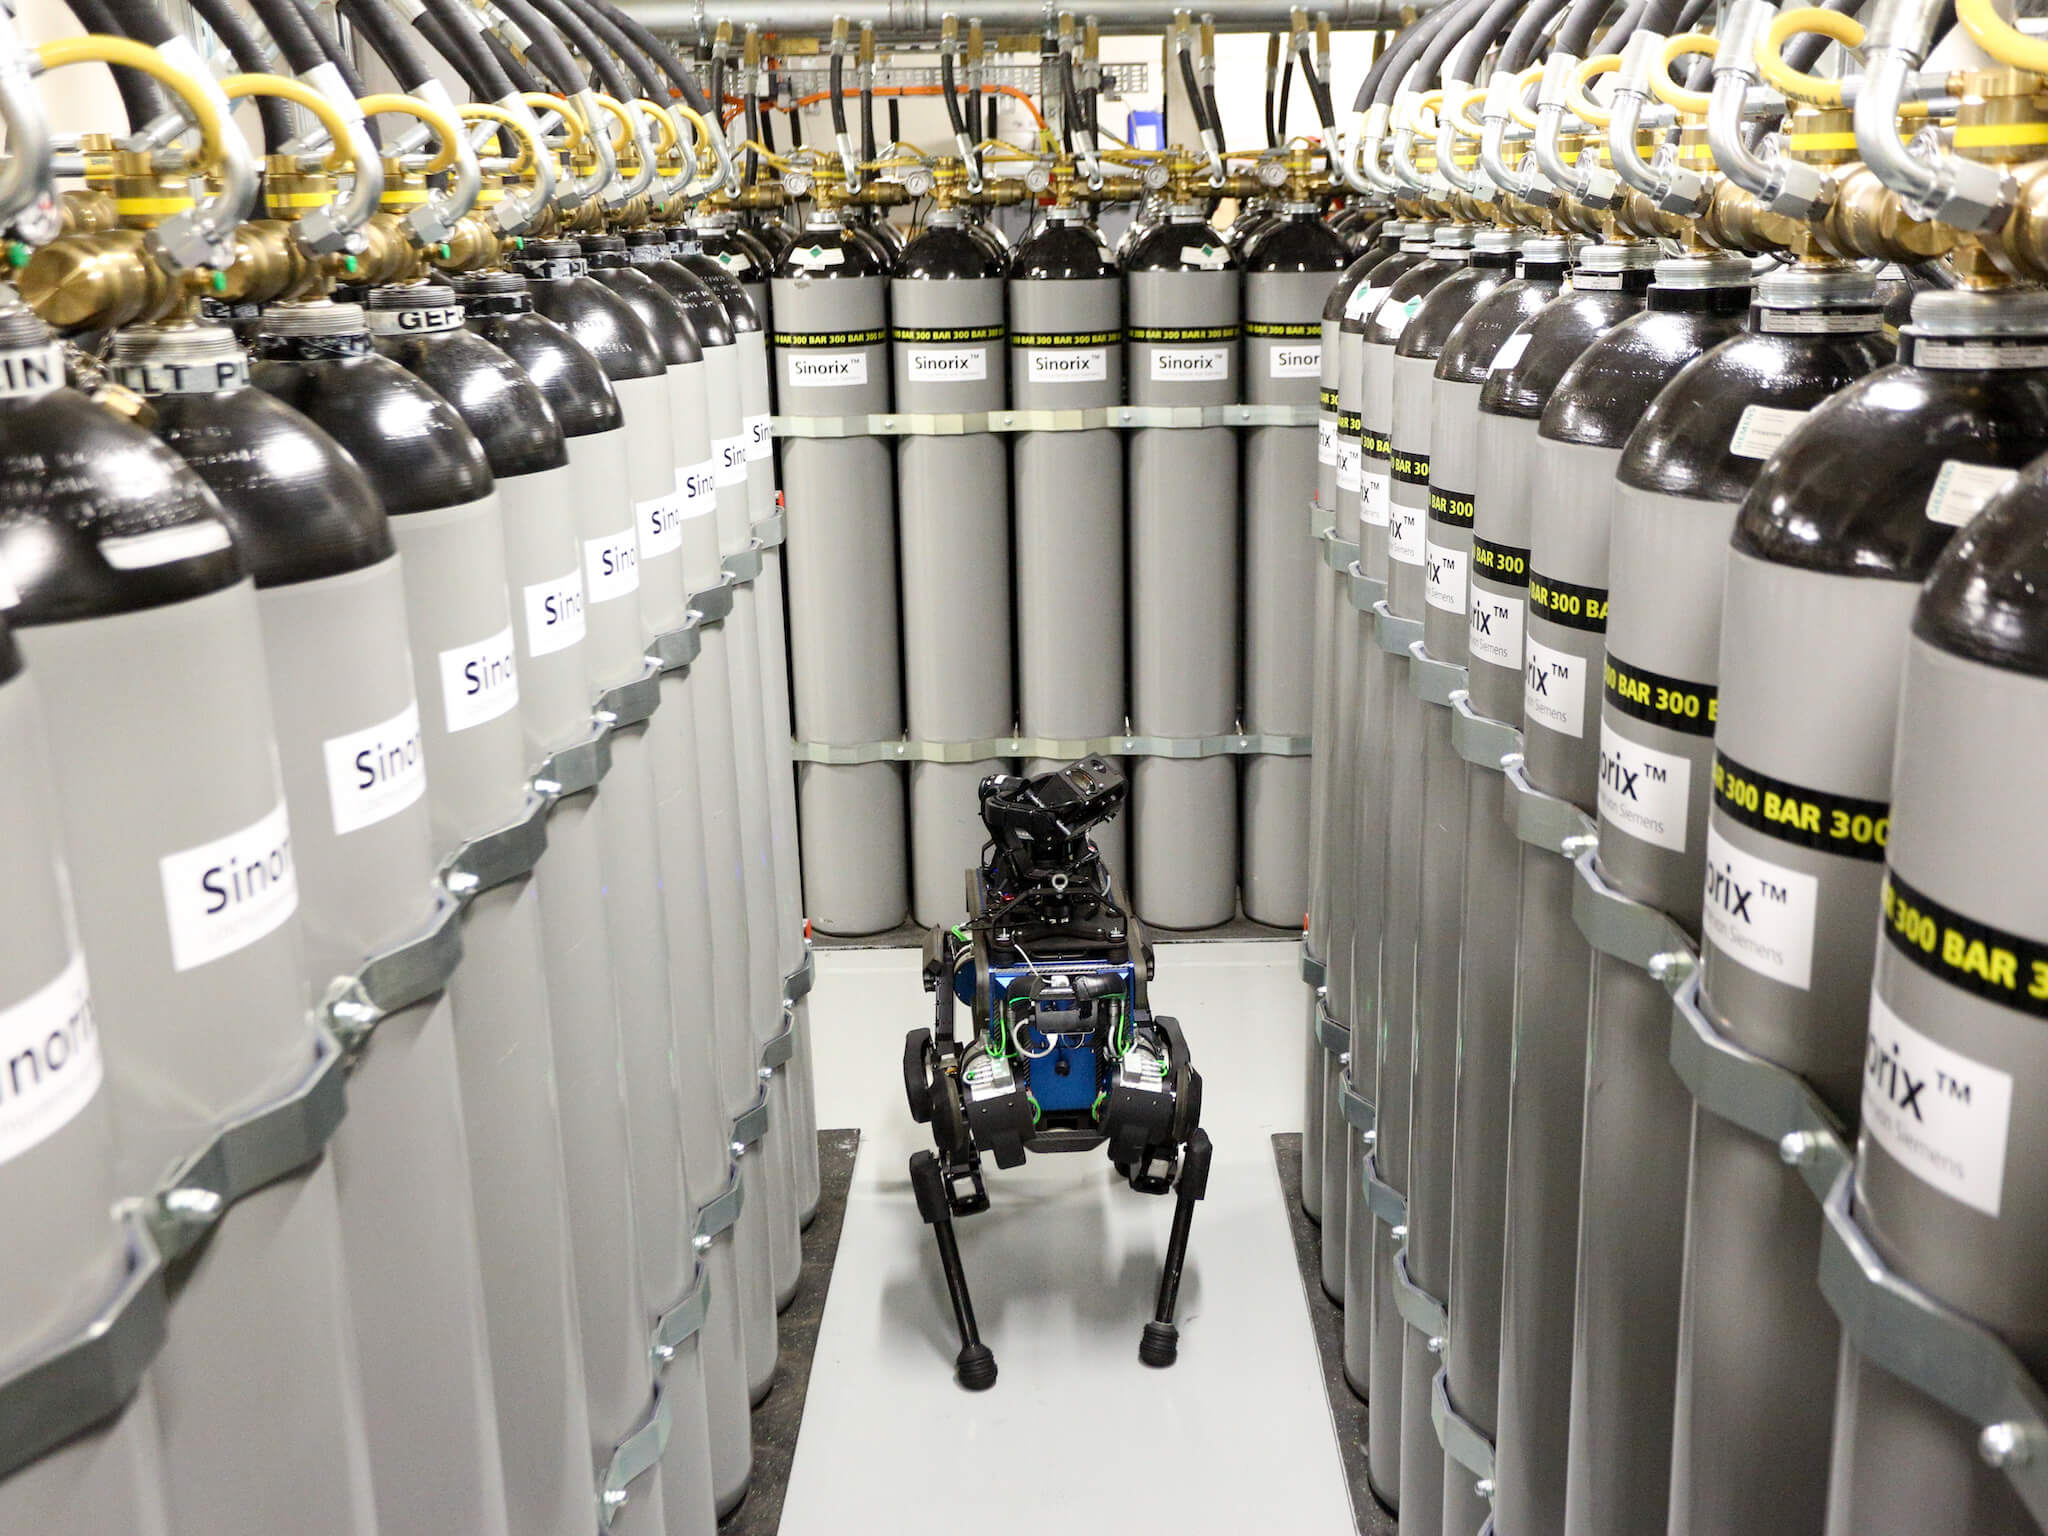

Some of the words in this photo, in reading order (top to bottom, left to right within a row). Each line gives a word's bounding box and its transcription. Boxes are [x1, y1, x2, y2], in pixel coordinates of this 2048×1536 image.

[915, 330, 931, 340] 300
[933, 330, 951, 340] BAR
[953, 329, 970, 339] 300
[971, 328, 987, 338] BAR
[1286, 325, 1305, 335] BAR
[792, 336, 807, 345] 300
[809, 335, 827, 345] BAR
[829, 335, 846, 344] 300
[848, 333, 864, 343] BAR
[1036, 336, 1051, 346] 300
[1054, 335, 1072, 345] BAR
[1075, 335, 1091, 345] 300
[1092, 333, 1107, 344] BAR
[1278, 352, 1320, 366] Sinor
[1349, 418, 1361, 431] 30
[1363, 436, 1375, 450] 300
[1395, 458, 1412, 475] BAR
[1414, 462, 1429, 477] 30
[1431, 494, 1447, 513] BAR
[1449, 502, 1473, 517] 300
[1476, 546, 1494, 568] BAR
[1497, 553, 1524, 574] 300
[1531, 580, 1548, 607] BAR
[1550, 591, 1580, 615] 300
[1618, 672, 1650, 707] BAR
[1655, 688, 1700, 718] 300
[1725, 772, 1758, 813] 300
[1763, 791, 1821, 834] BAR
[1829, 809, 1890, 847] 300
[1894, 898, 1936, 952] 300
[1941, 927, 2018, 990] BAR
